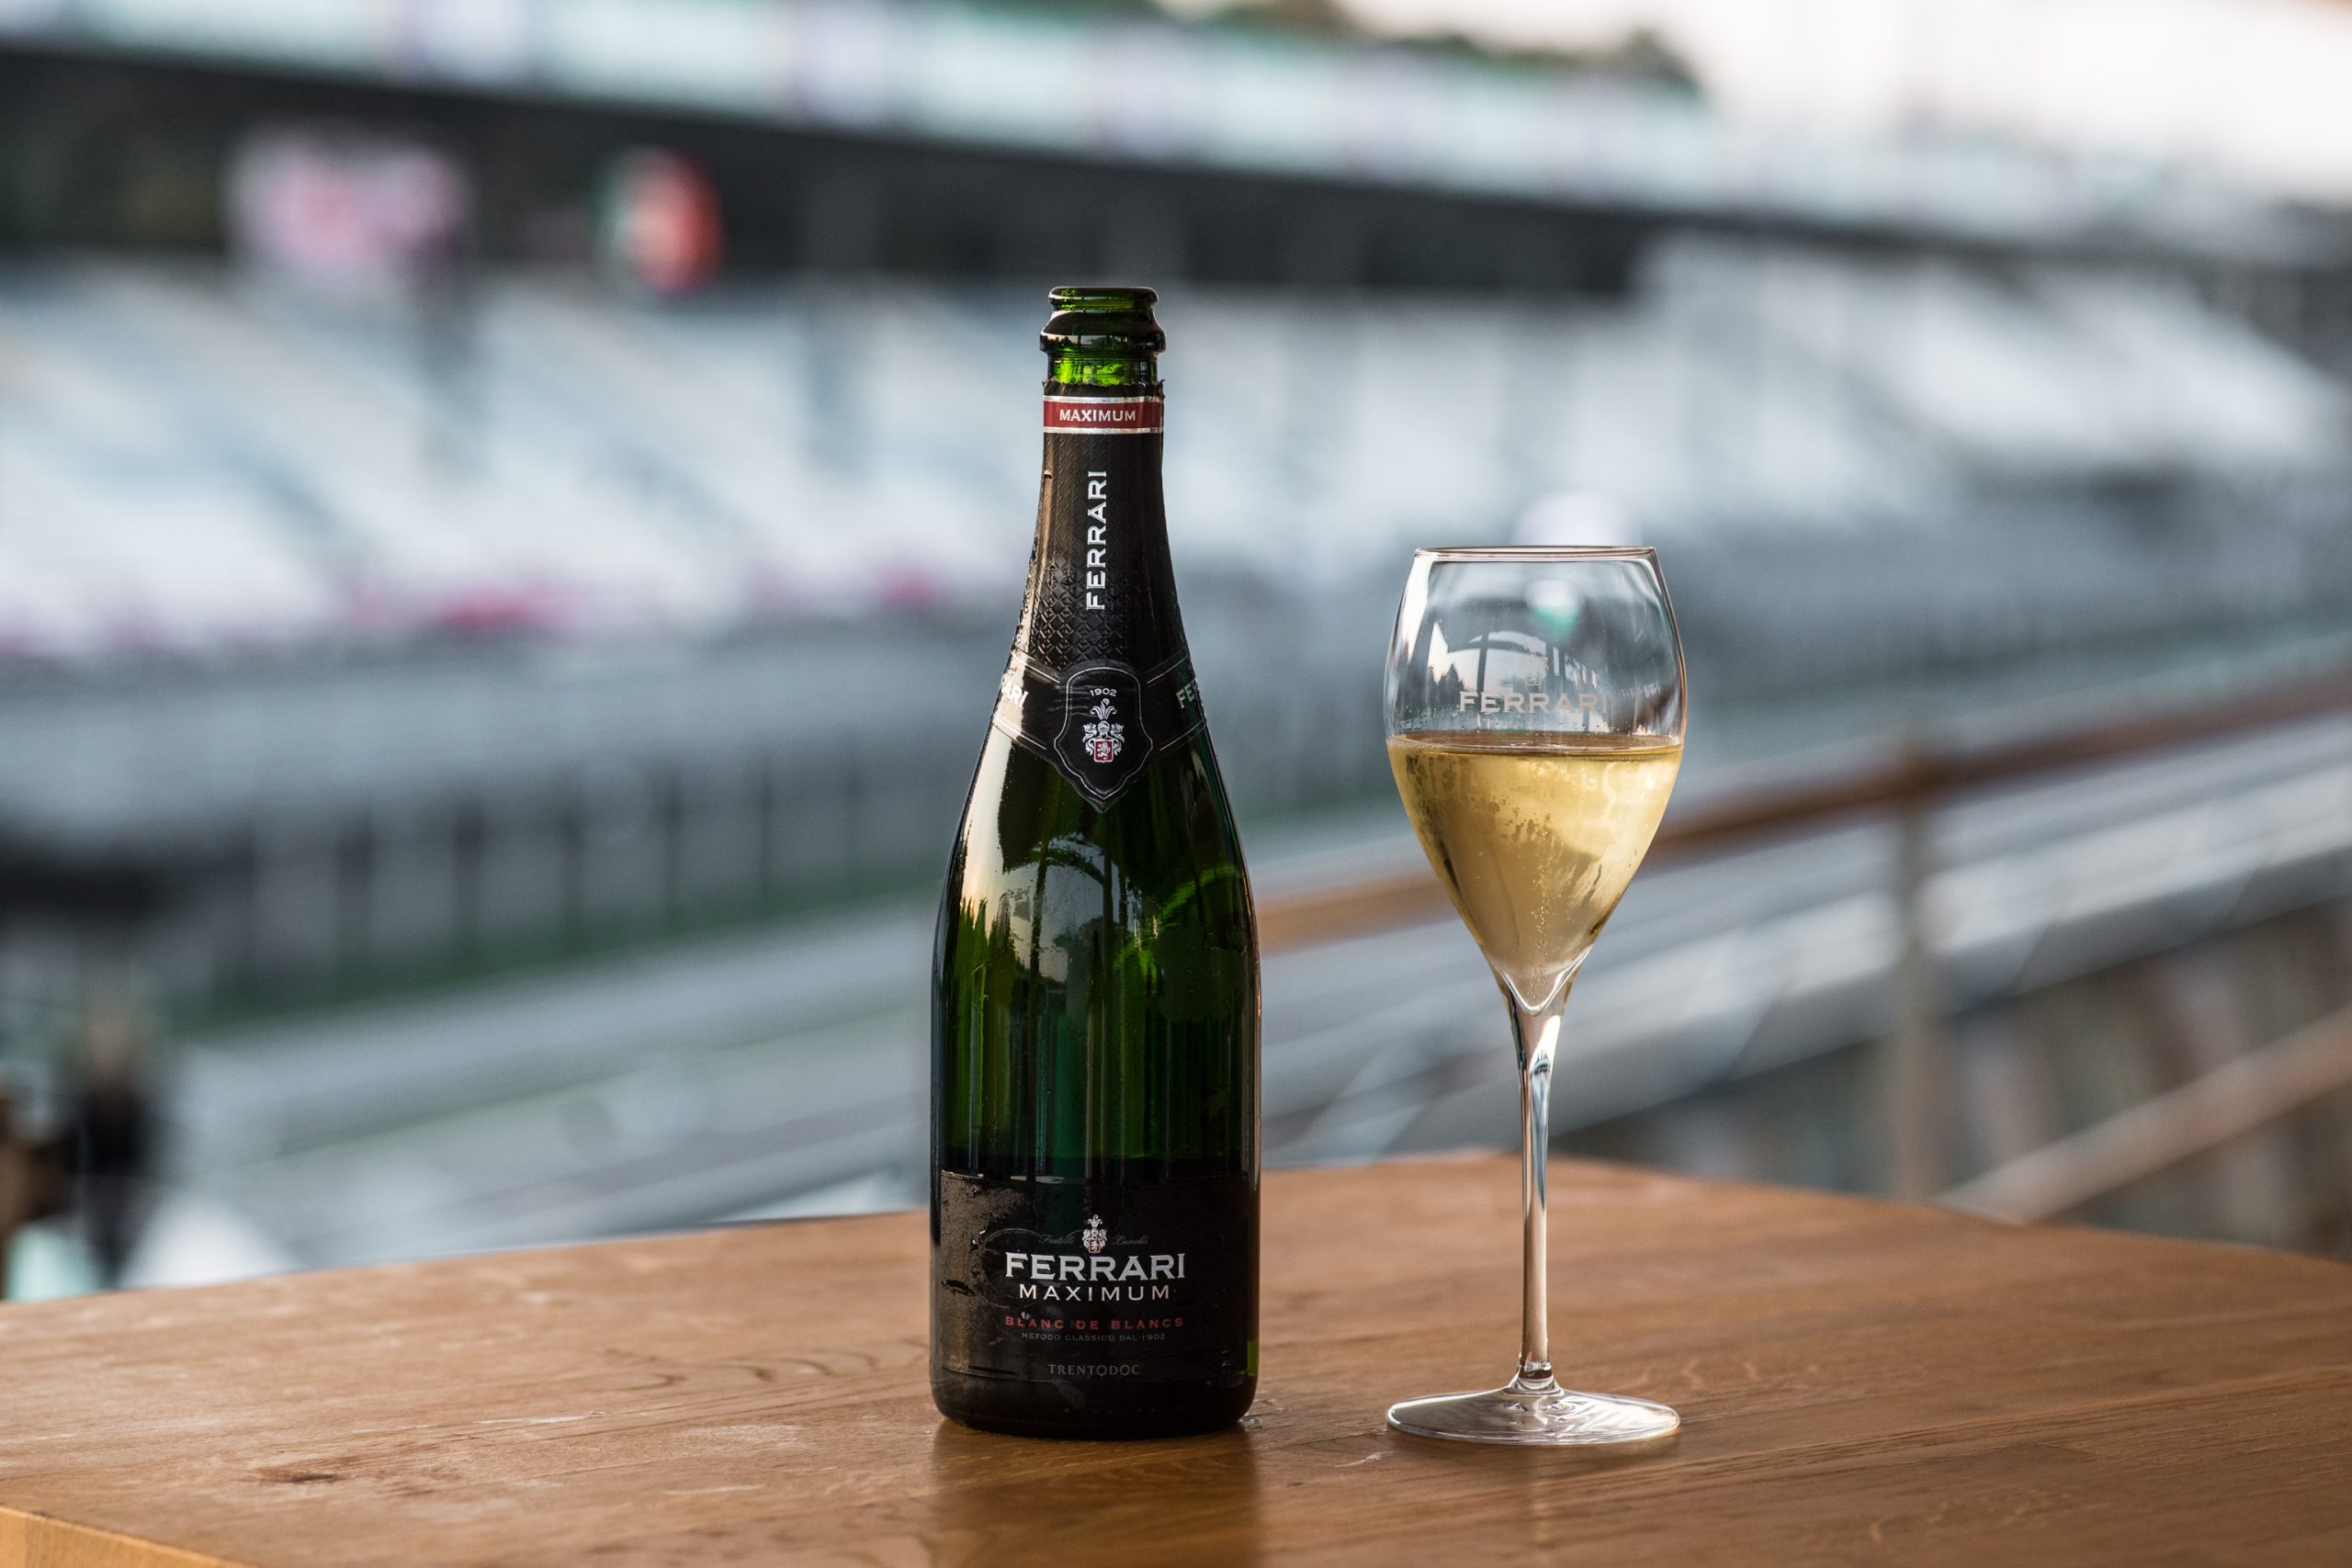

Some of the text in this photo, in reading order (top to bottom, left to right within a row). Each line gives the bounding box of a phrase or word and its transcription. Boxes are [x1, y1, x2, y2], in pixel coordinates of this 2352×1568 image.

[1059, 409, 1136, 422] MAXIMUM
[1086, 470, 1107, 610] FERRARI
[1090, 687, 1117, 697] 1902
[1459, 691, 1608, 714] FERRARI
[1005, 1251, 1186, 1281] FERRARI
[1019, 1283, 1170, 1302] MAXIMUM
[1004, 1315, 1184, 1330] BLANC DE BLANCS
[1022, 1332, 1061, 1341] METODO
[1065, 1334, 1115, 1342] CLASSICO
[1142, 1333, 1166, 1341] 1902
[1048, 1363, 1140, 1376] TRENTODOC
